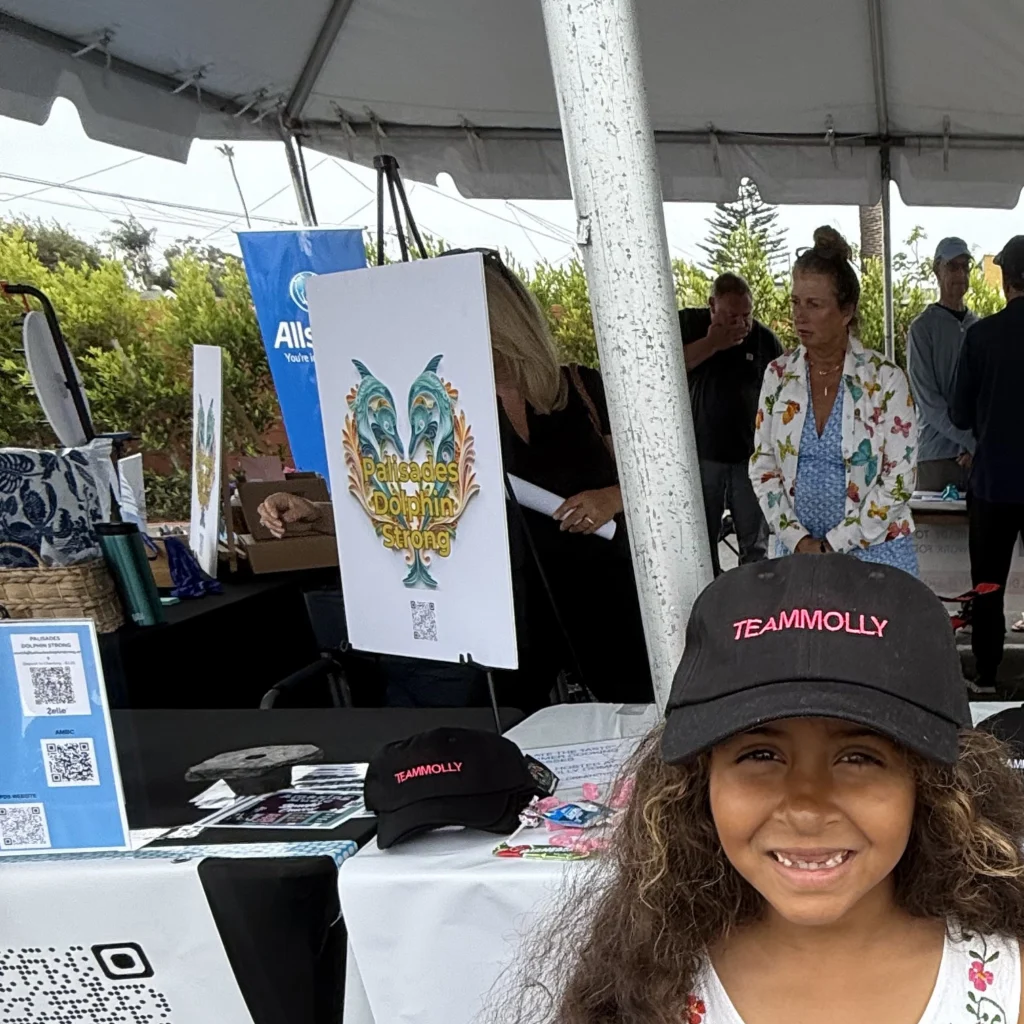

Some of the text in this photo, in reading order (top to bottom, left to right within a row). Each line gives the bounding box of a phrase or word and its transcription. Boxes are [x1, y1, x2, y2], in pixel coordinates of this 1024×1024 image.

[273, 321, 313, 349] Alls
[361, 454, 460, 483] Palisades
[373, 490, 455, 521] Dolphin
[382, 523, 451, 557] Strong
[733, 609, 888, 640] TEAMMOLLY
[394, 762, 463, 784] TEAMMOLLY
